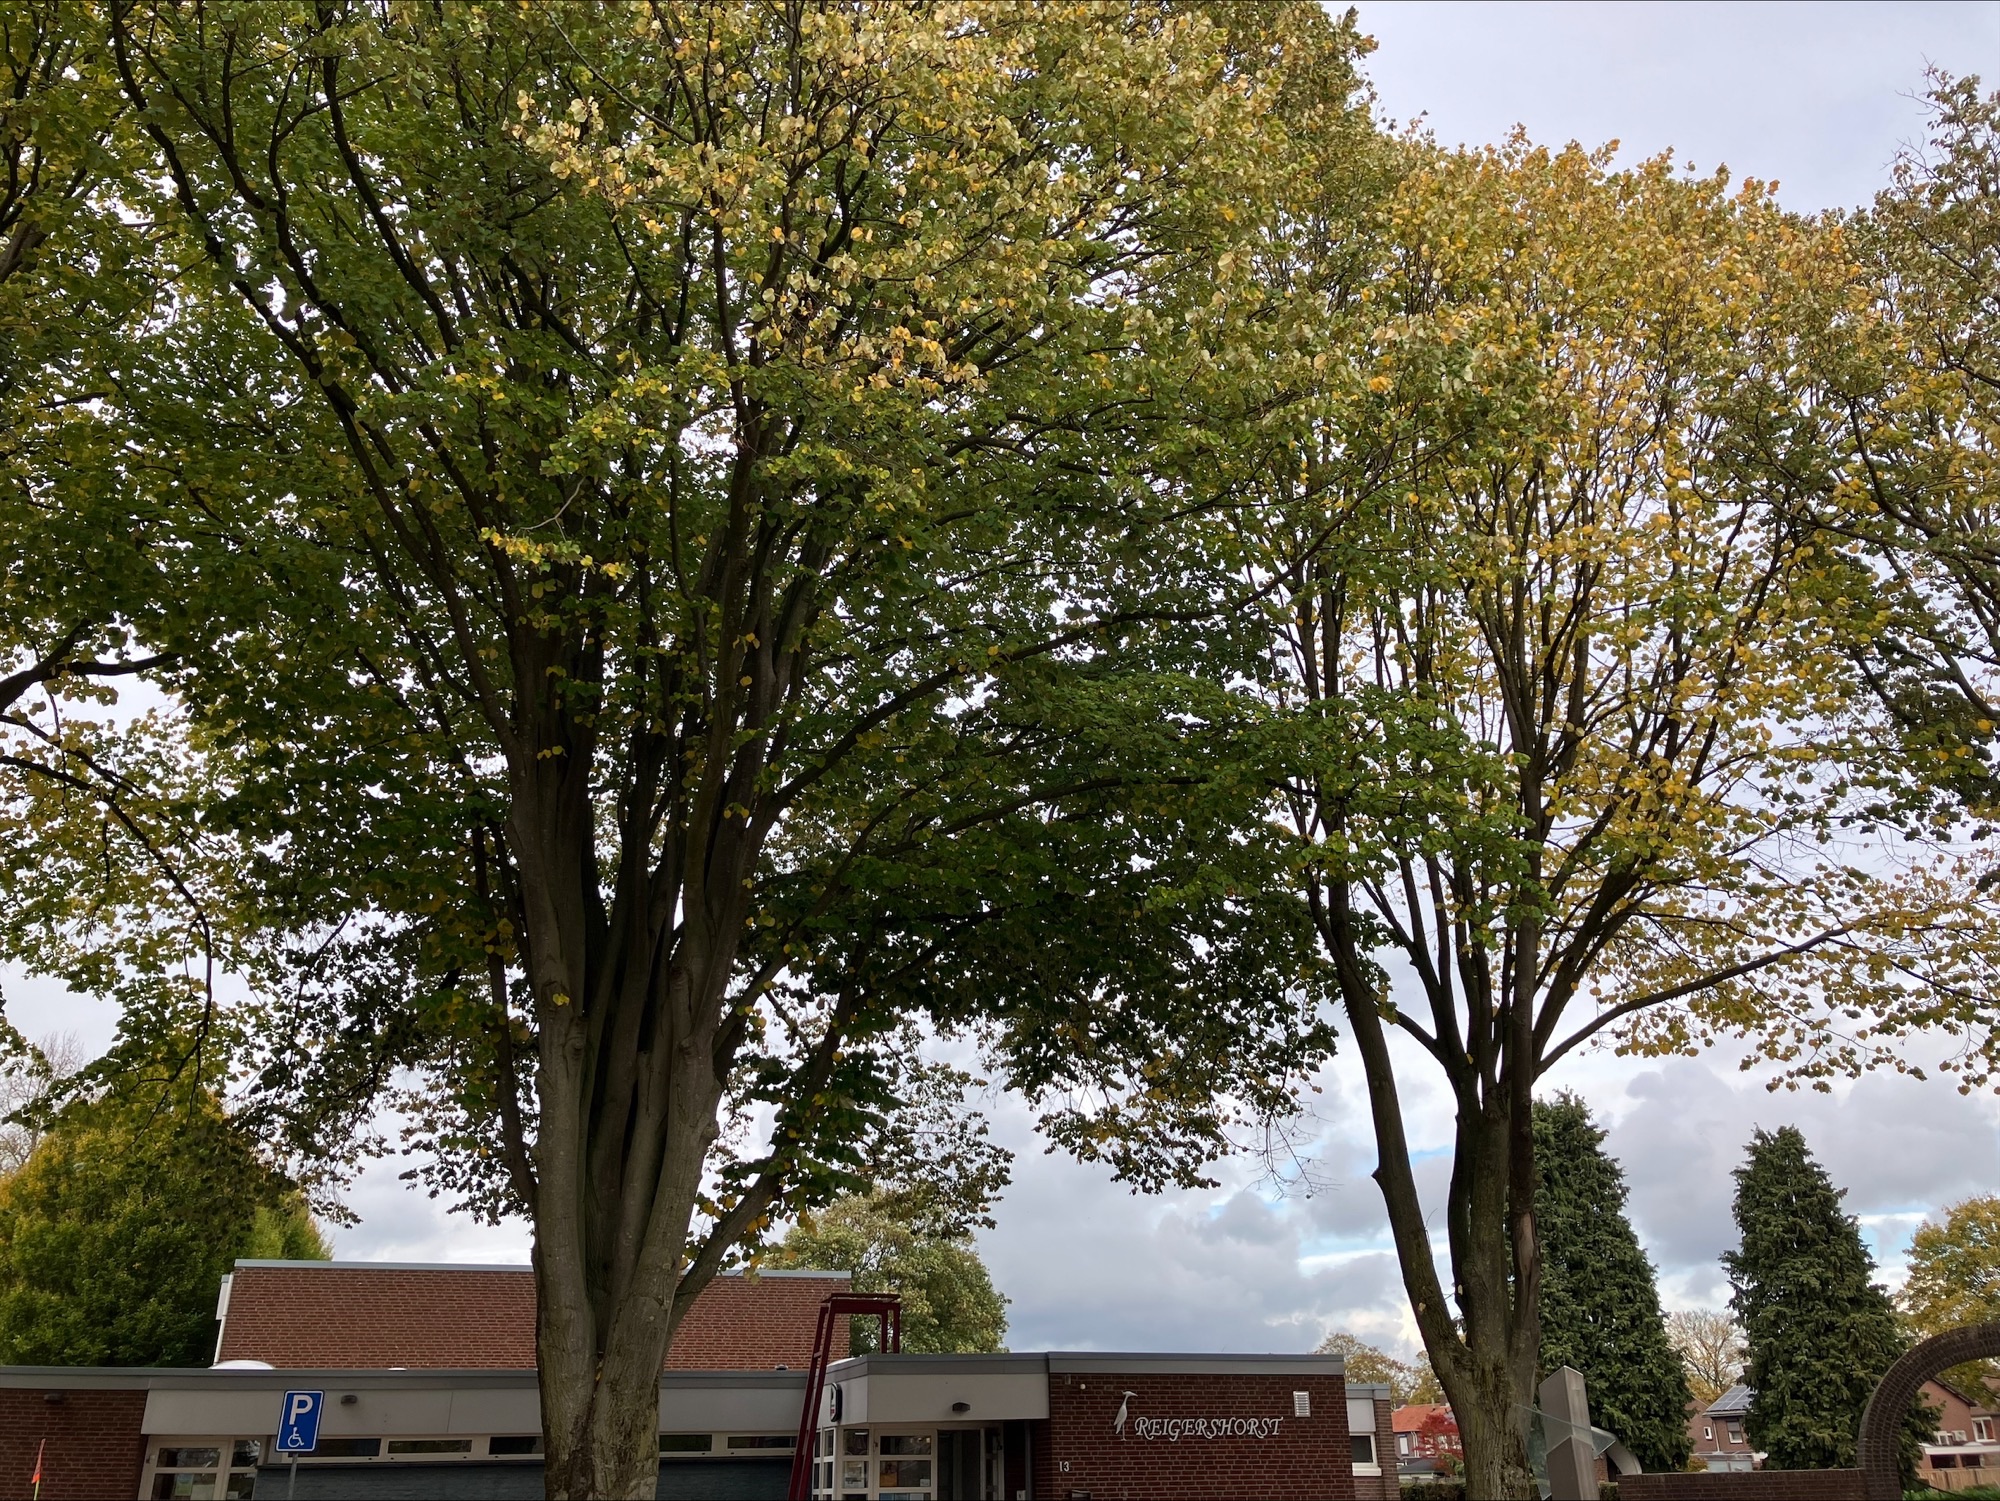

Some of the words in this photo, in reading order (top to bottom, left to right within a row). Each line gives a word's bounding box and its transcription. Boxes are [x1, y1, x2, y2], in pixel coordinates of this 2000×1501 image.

[289, 1394, 313, 1425] P
[1134, 1416, 1284, 1441] REIGERSHORST
[1059, 1461, 1070, 1472] 13
